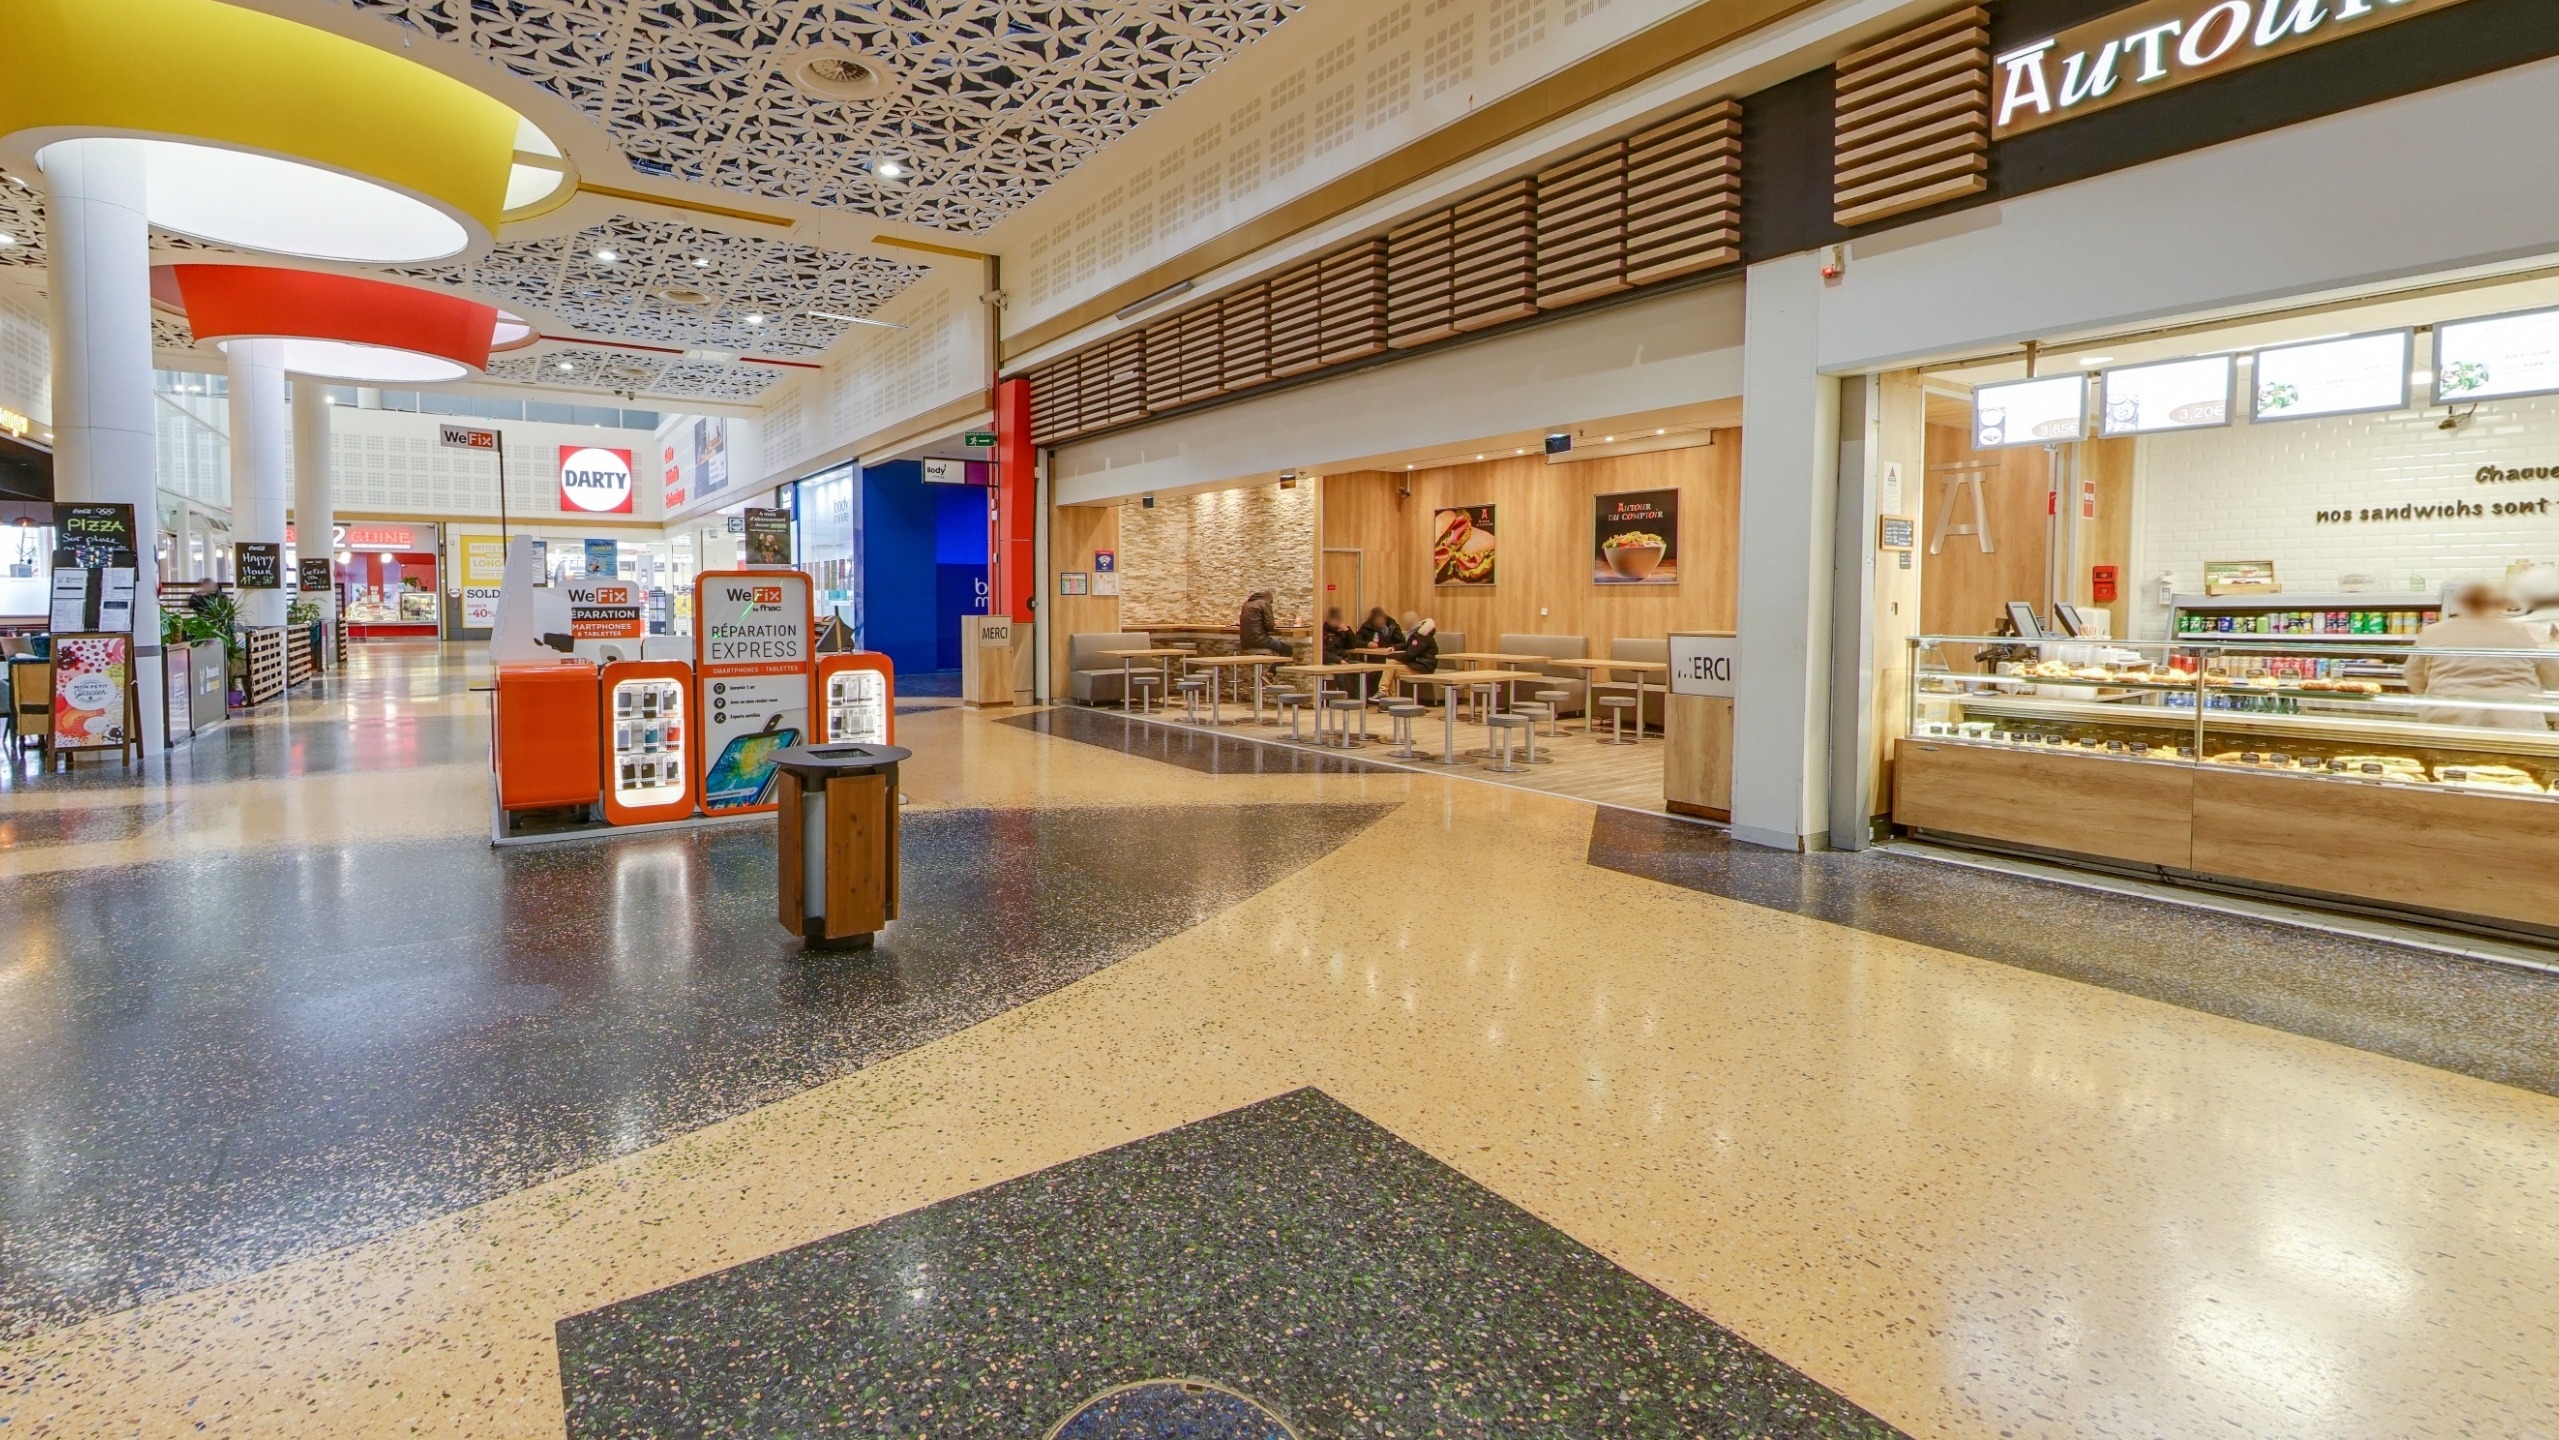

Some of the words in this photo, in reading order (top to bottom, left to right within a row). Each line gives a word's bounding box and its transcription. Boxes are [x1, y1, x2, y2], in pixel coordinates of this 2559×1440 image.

[444, 430, 492, 446] WeFix
[565, 470, 628, 489] DARTY
[2316, 510, 2352, 524] nos
[2360, 499, 2484, 522] sandwichs
[2491, 498, 2549, 516] sont
[67, 518, 126, 532] PIZZA
[242, 552, 275, 570] Happy
[467, 589, 500, 599] SOLD
[568, 589, 626, 603] WeFix
[727, 588, 780, 602] WeFix
[760, 604, 782, 612] fnac
[711, 623, 797, 638] RÉPARATION
[982, 627, 1008, 639] MERCI
[712, 640, 797, 659] EXPRESS
[713, 666, 759, 674] SMARTPHONES
